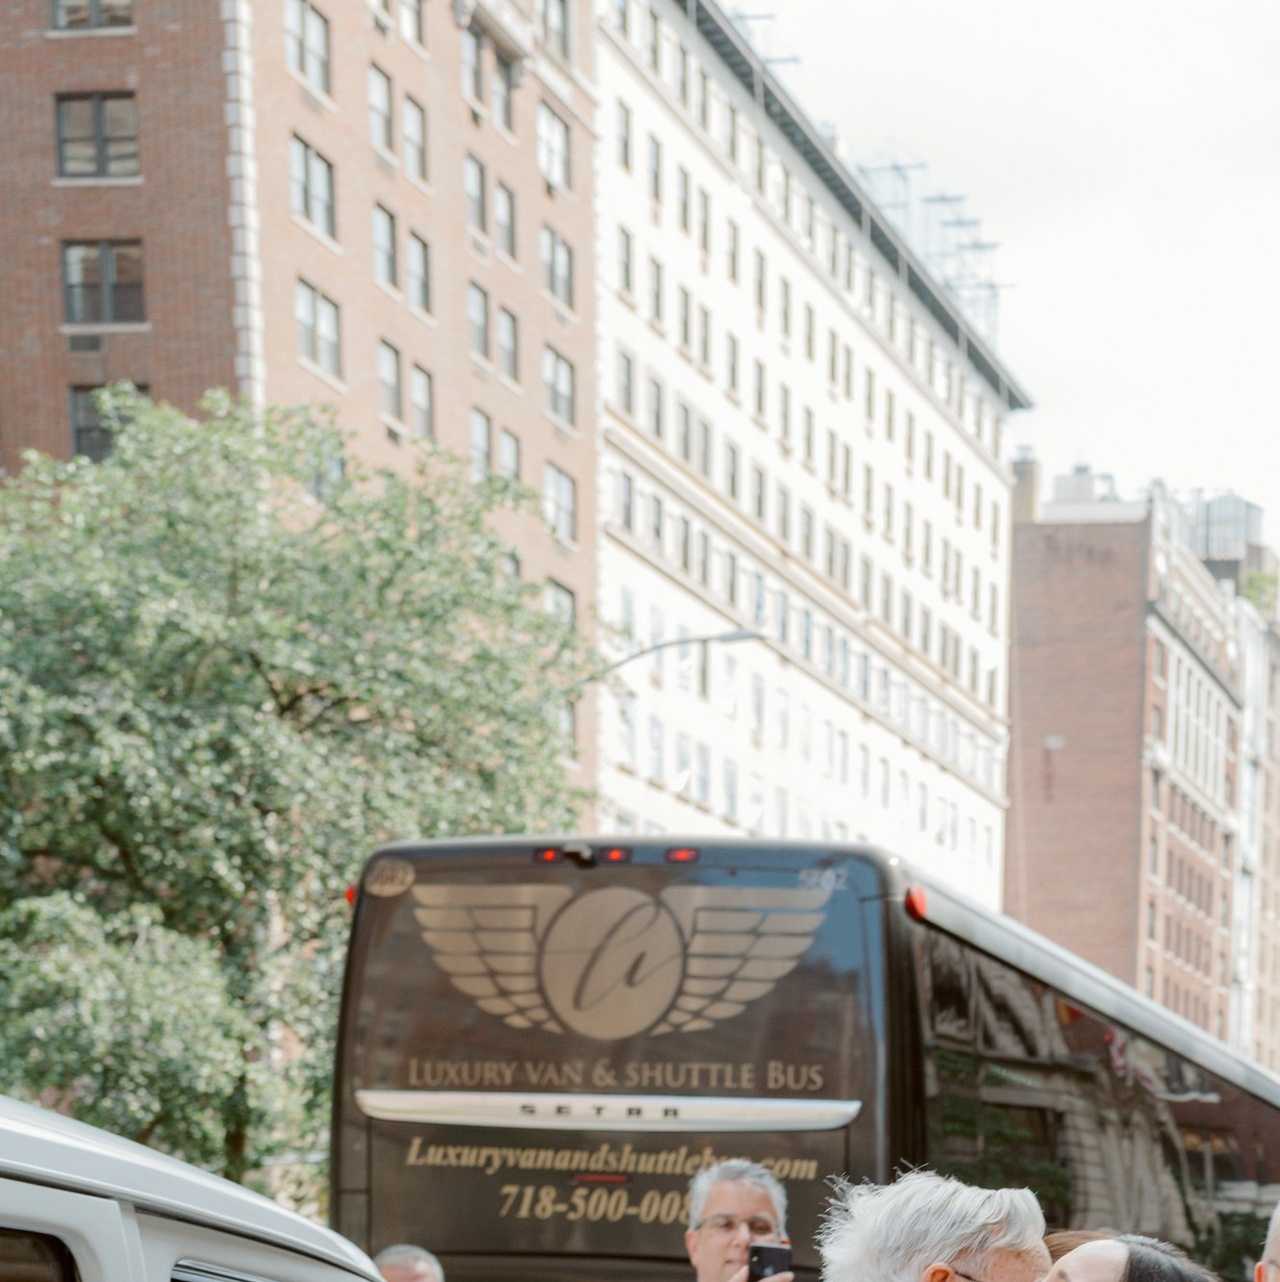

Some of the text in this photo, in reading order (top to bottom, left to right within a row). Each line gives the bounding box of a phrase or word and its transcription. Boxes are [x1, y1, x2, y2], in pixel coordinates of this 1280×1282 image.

[408, 1057, 825, 1091] LUXURY VAN & SHUTTLE BUS
[520, 1104, 679, 1118] SETRA
